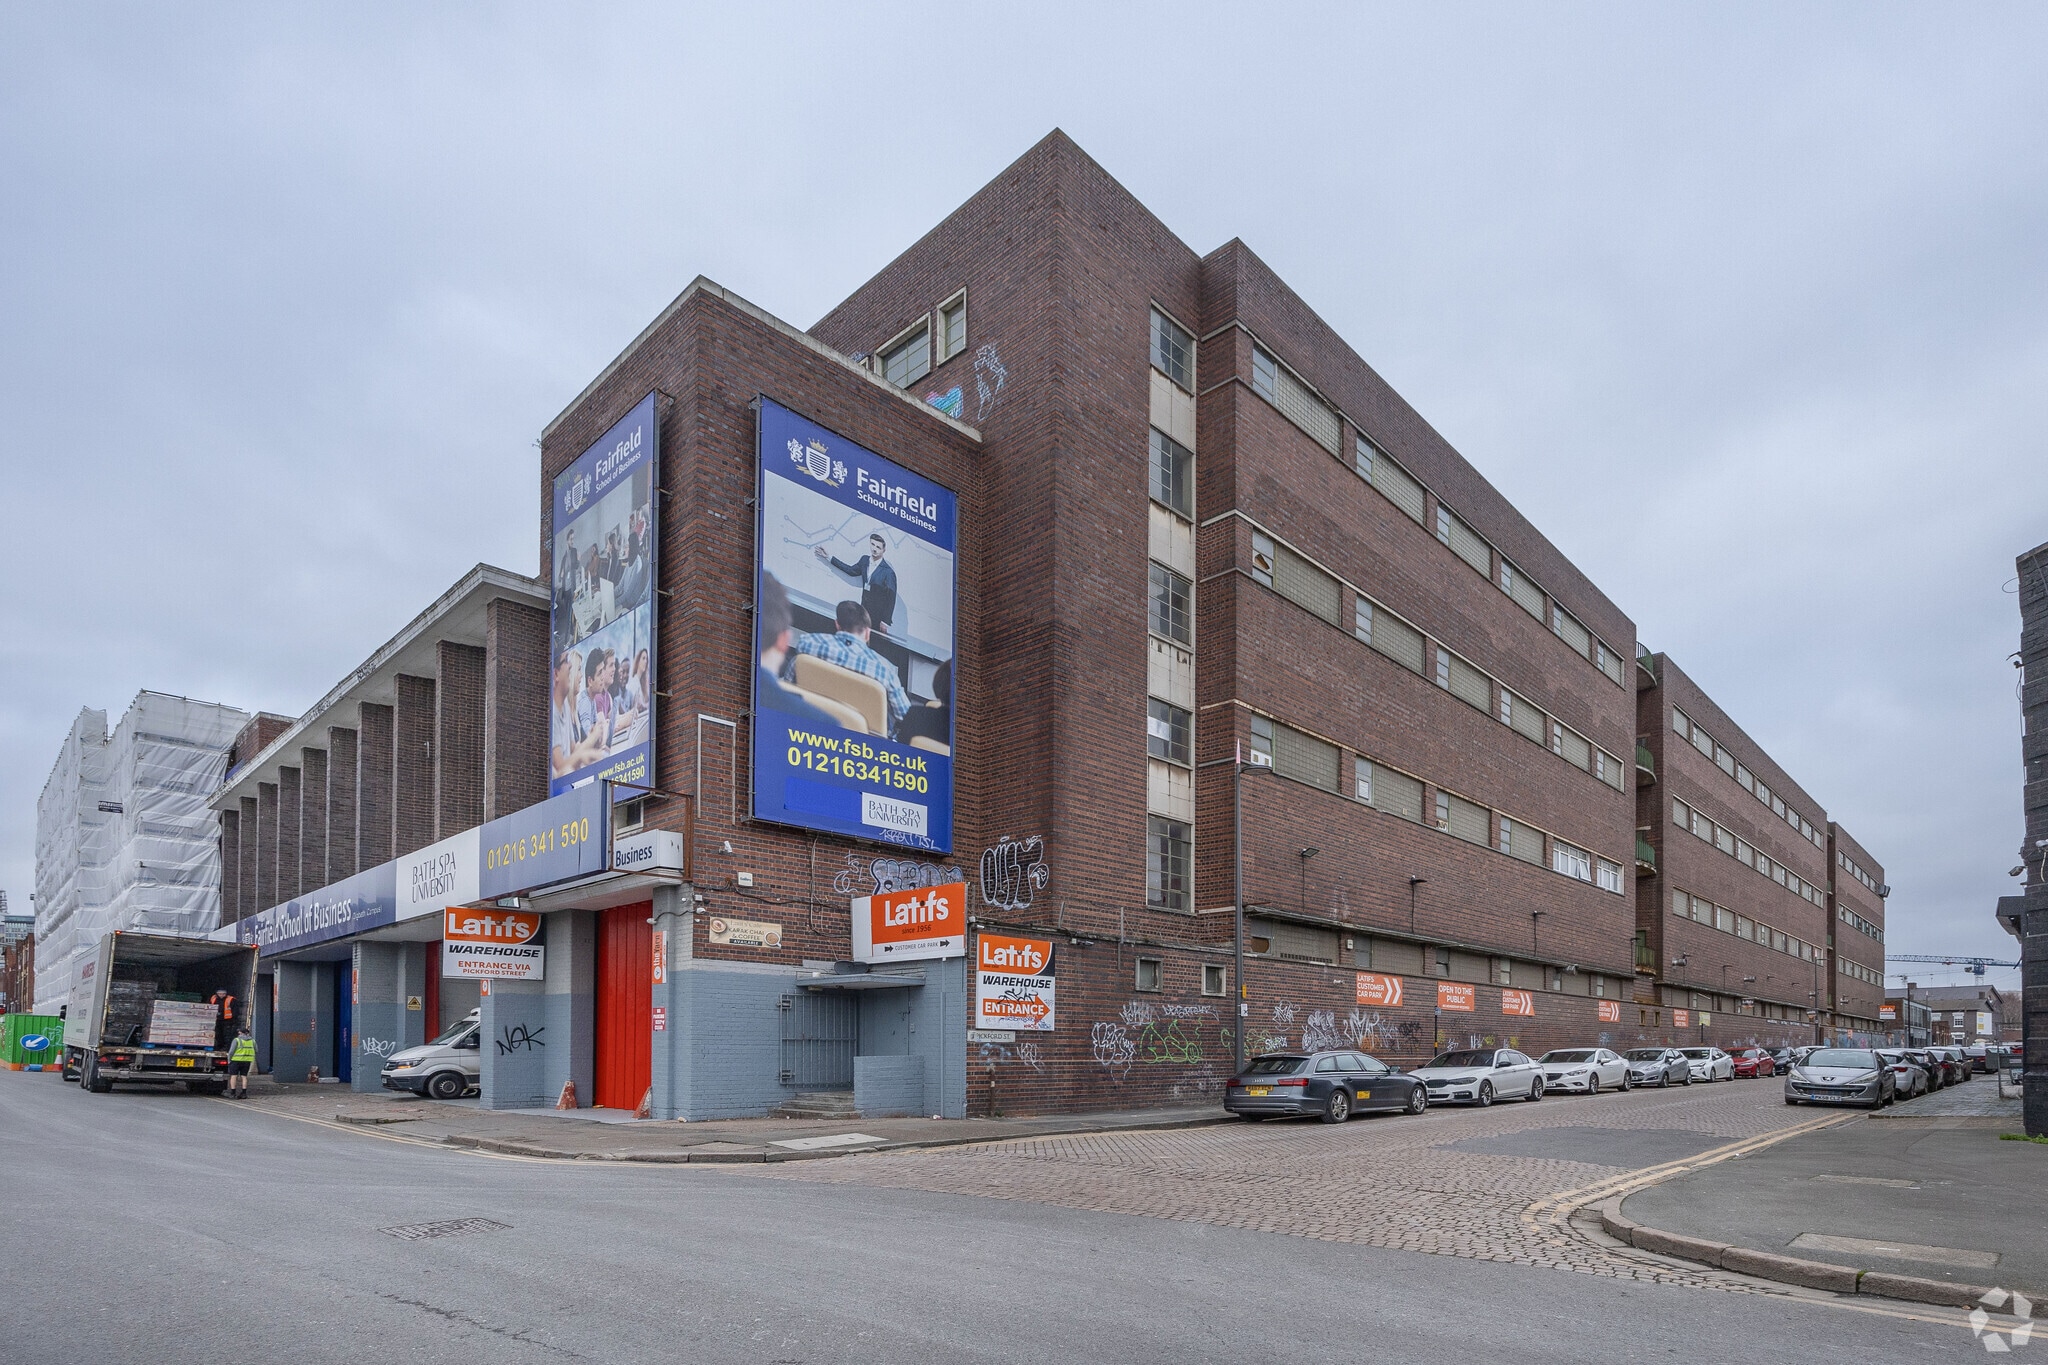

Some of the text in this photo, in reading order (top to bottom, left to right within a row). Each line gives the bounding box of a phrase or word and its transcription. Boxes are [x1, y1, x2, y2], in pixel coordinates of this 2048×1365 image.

[595, 425, 642, 482] Fairfield
[595, 451, 642, 493] School of Business
[857, 467, 937, 521] Fairfield
[857, 489, 937, 533] School of Business
[788, 728, 928, 773] www.fsb.ac.uk
[598, 752, 645, 780] www.fsb.ac.uk
[787, 746, 928, 794] 01216341590
[869, 800, 921, 820] BATH SPA
[869, 809, 921, 829] UNIVERSITY
[487, 817, 589, 870] 01216 341 590
[412, 851, 456, 885] BATH SPA
[615, 845, 653, 867] Business
[412, 871, 457, 904] UNIVERSITY
[885, 890, 949, 927] Latifs
[254, 898, 351, 946] Fairfield School of Business
[448, 913, 530, 939] Latifs
[902, 924, 932, 935] since 1956
[449, 944, 541, 958] WAREHOUSE
[895, 943, 916, 951] CUSTOMER
[983, 941, 1043, 969] Latifs
[458, 960, 531, 971] ENTRANCE VIA
[983, 975, 1052, 989] WAREHOUSE
[1357, 975, 1374, 983] LATIFS
[1357, 982, 1385, 991] CUSTOMER
[1438, 985, 1473, 996] OPEN TO THE
[1368, 991, 1383, 999] PARK
[1446, 994, 1466, 1004] PUBLIC
[985, 1001, 1045, 1015] ENTRANCE
